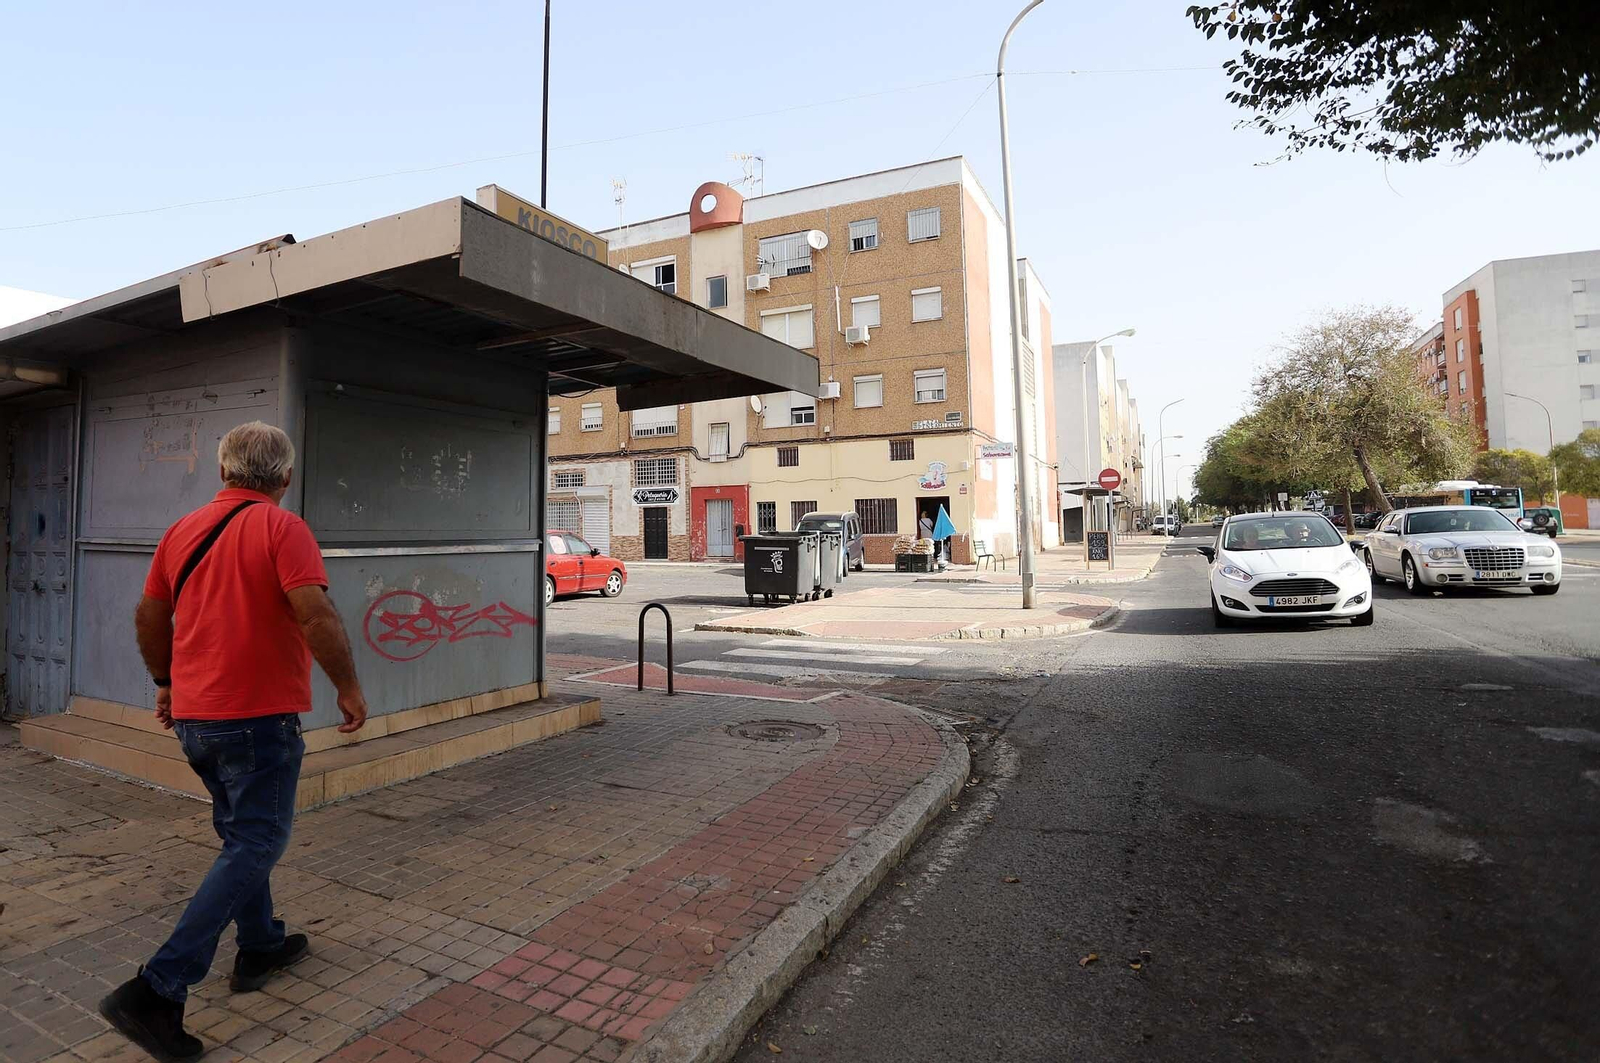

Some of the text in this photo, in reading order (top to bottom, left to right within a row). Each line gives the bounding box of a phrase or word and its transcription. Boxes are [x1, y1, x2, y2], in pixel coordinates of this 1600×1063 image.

[518, 207, 597, 259] KIOSCO
[1275, 596, 1318, 605] 4982 JKF
